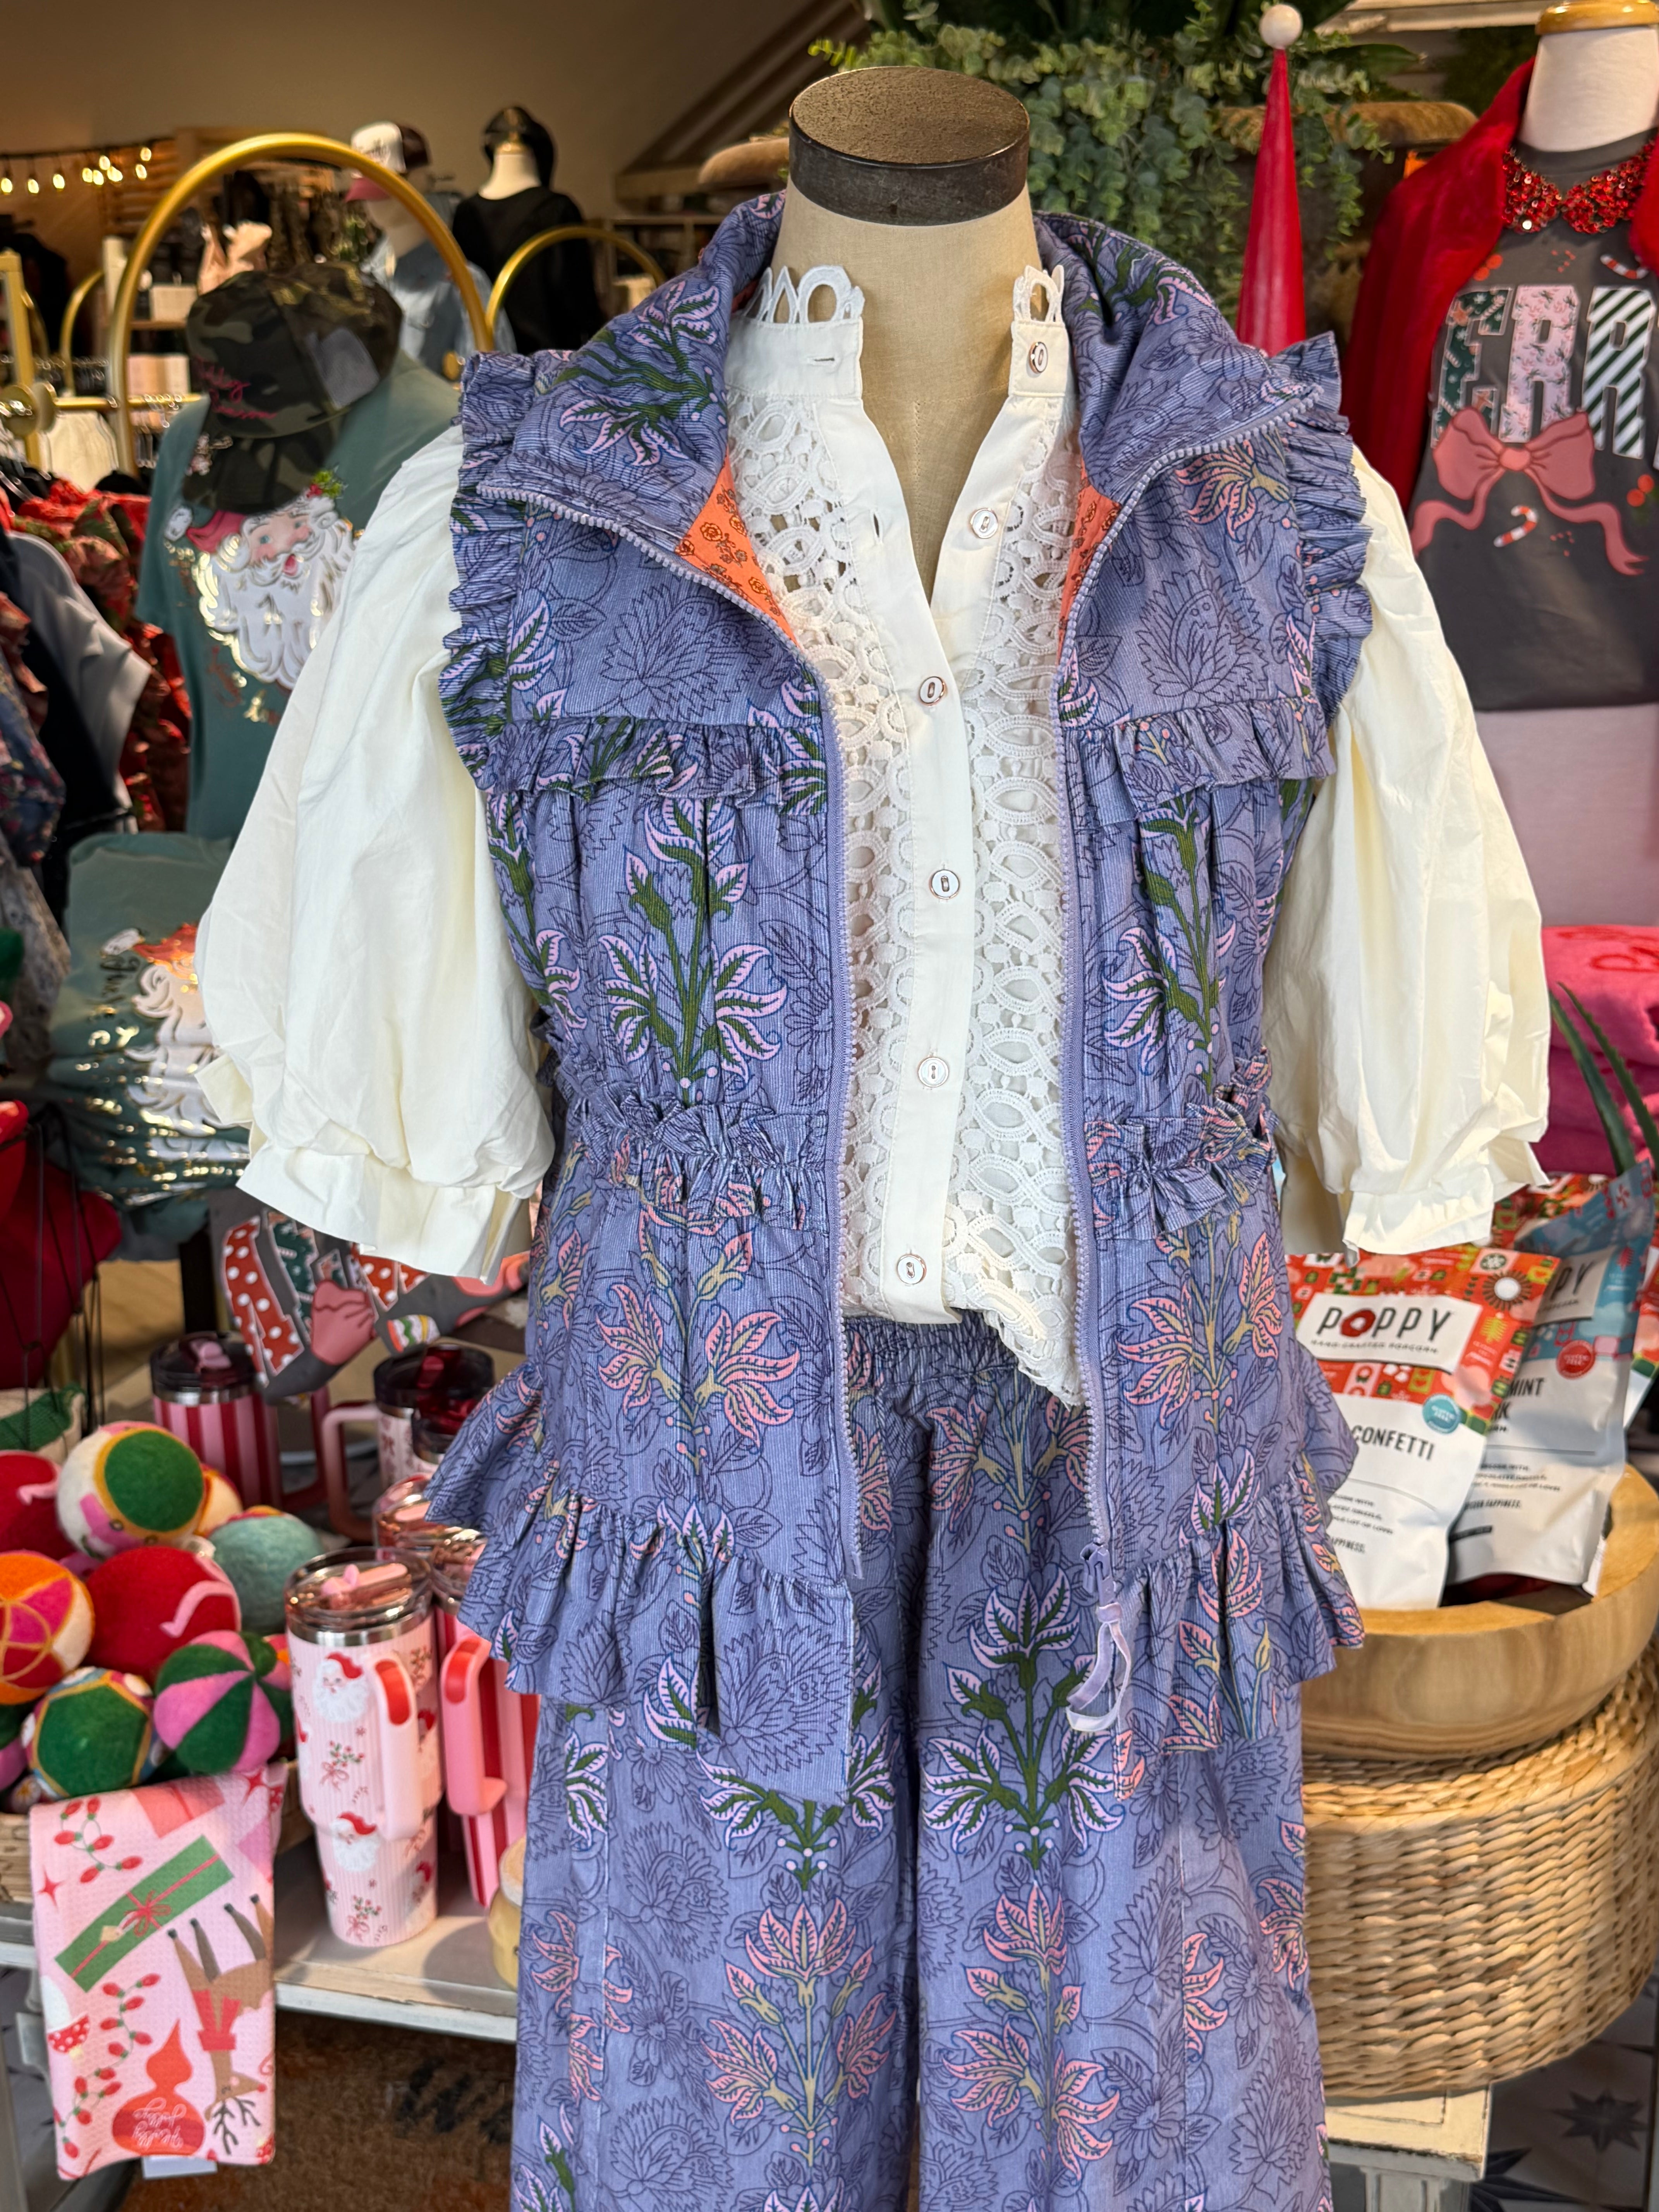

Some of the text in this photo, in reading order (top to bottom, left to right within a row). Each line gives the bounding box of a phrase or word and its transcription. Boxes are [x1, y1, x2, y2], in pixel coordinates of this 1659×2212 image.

[1431, 284, 1659, 462] ERR
[1550, 1261, 1595, 1300] PY
[1316, 1306, 1452, 1342] POPPY
[1510, 1377, 1545, 1397] MINT
[1352, 1425, 1435, 1461] CONFETTI
